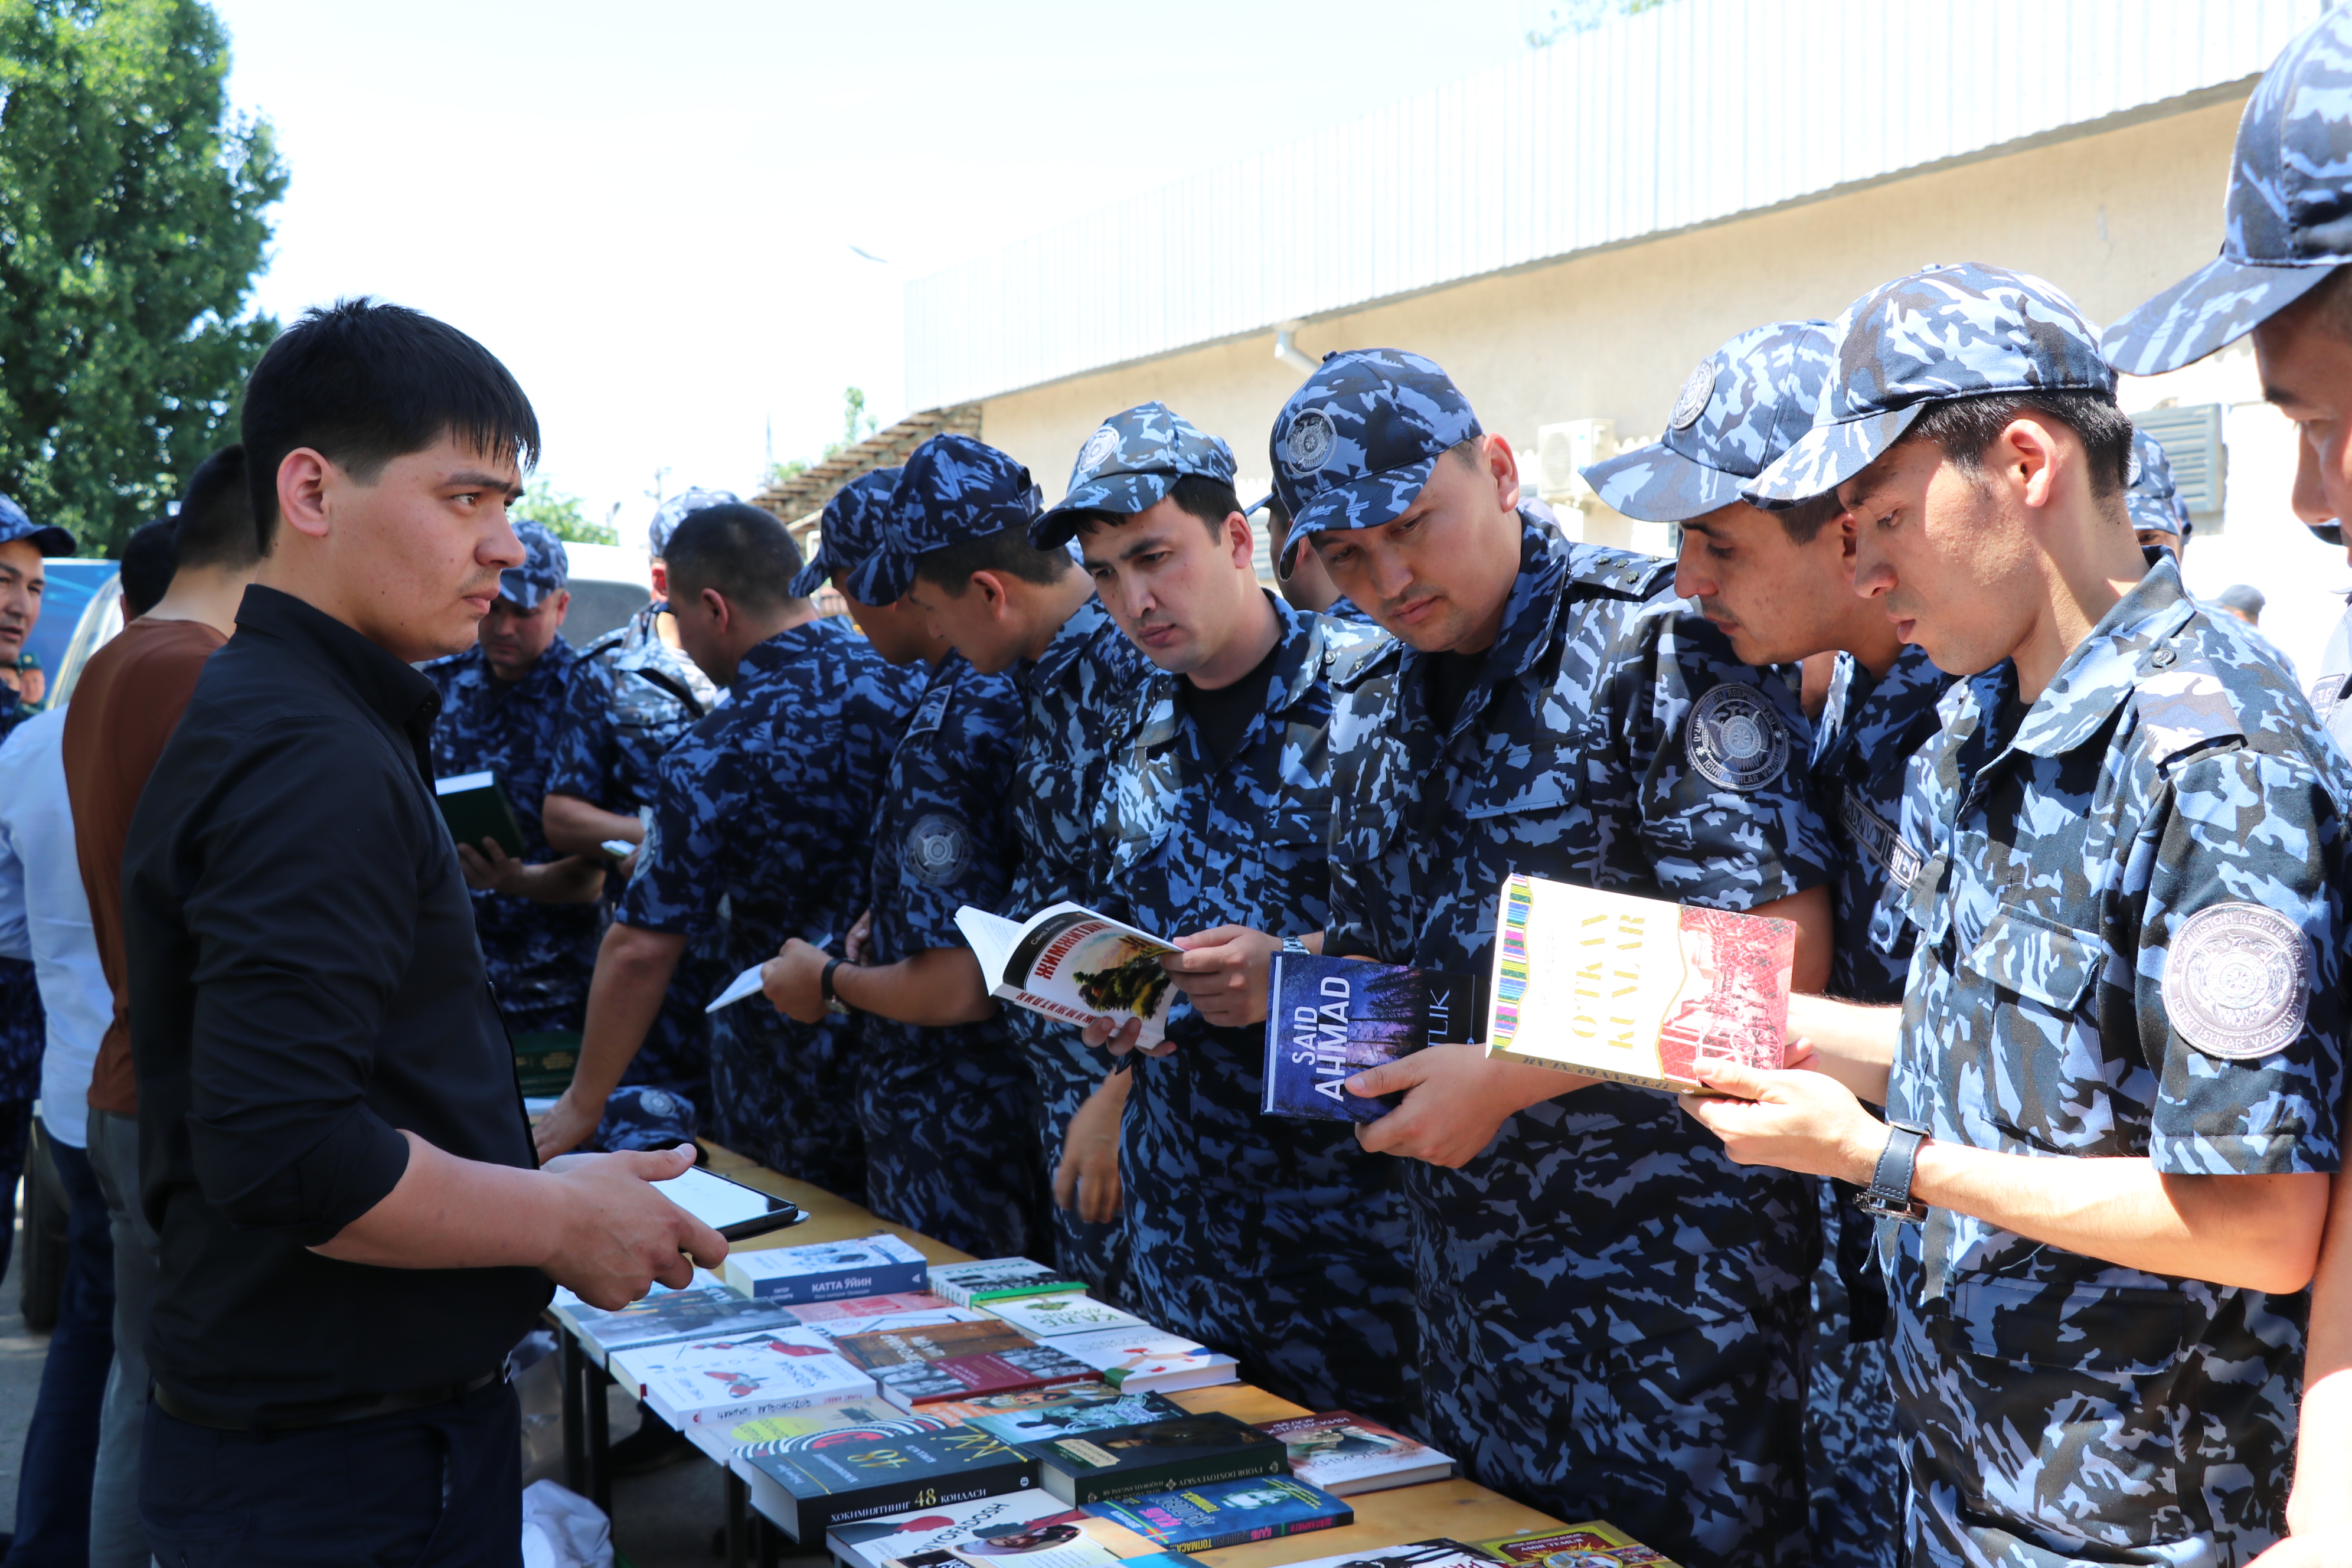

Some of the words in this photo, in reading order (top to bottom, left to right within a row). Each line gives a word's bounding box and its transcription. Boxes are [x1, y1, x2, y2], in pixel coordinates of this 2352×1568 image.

[1031, 929, 1049, 945] Саид
[1034, 920, 1112, 980] ЖИМЖИТЛИК
[1015, 991, 1096, 1024] ЖИМЖИТЛИК
[1427, 988, 1450, 1048] TLIK
[1292, 1006, 1318, 1066] SAID
[1315, 976, 1351, 1102] AHMAD
[812, 1280, 843, 1293] КАТТА
[844, 1277, 872, 1289] ЎЙИН
[847, 1449, 911, 1469] 48
[1178, 1469, 1236, 1487] DOSTOYEVSKIY
[914, 1488, 936, 1507] 48
[1291, 1520, 1315, 1533] КАРНЕГИ
[1316, 1517, 1332, 1528] ДЕЙЛ
[1547, 1537, 1584, 1547] TEMUR
